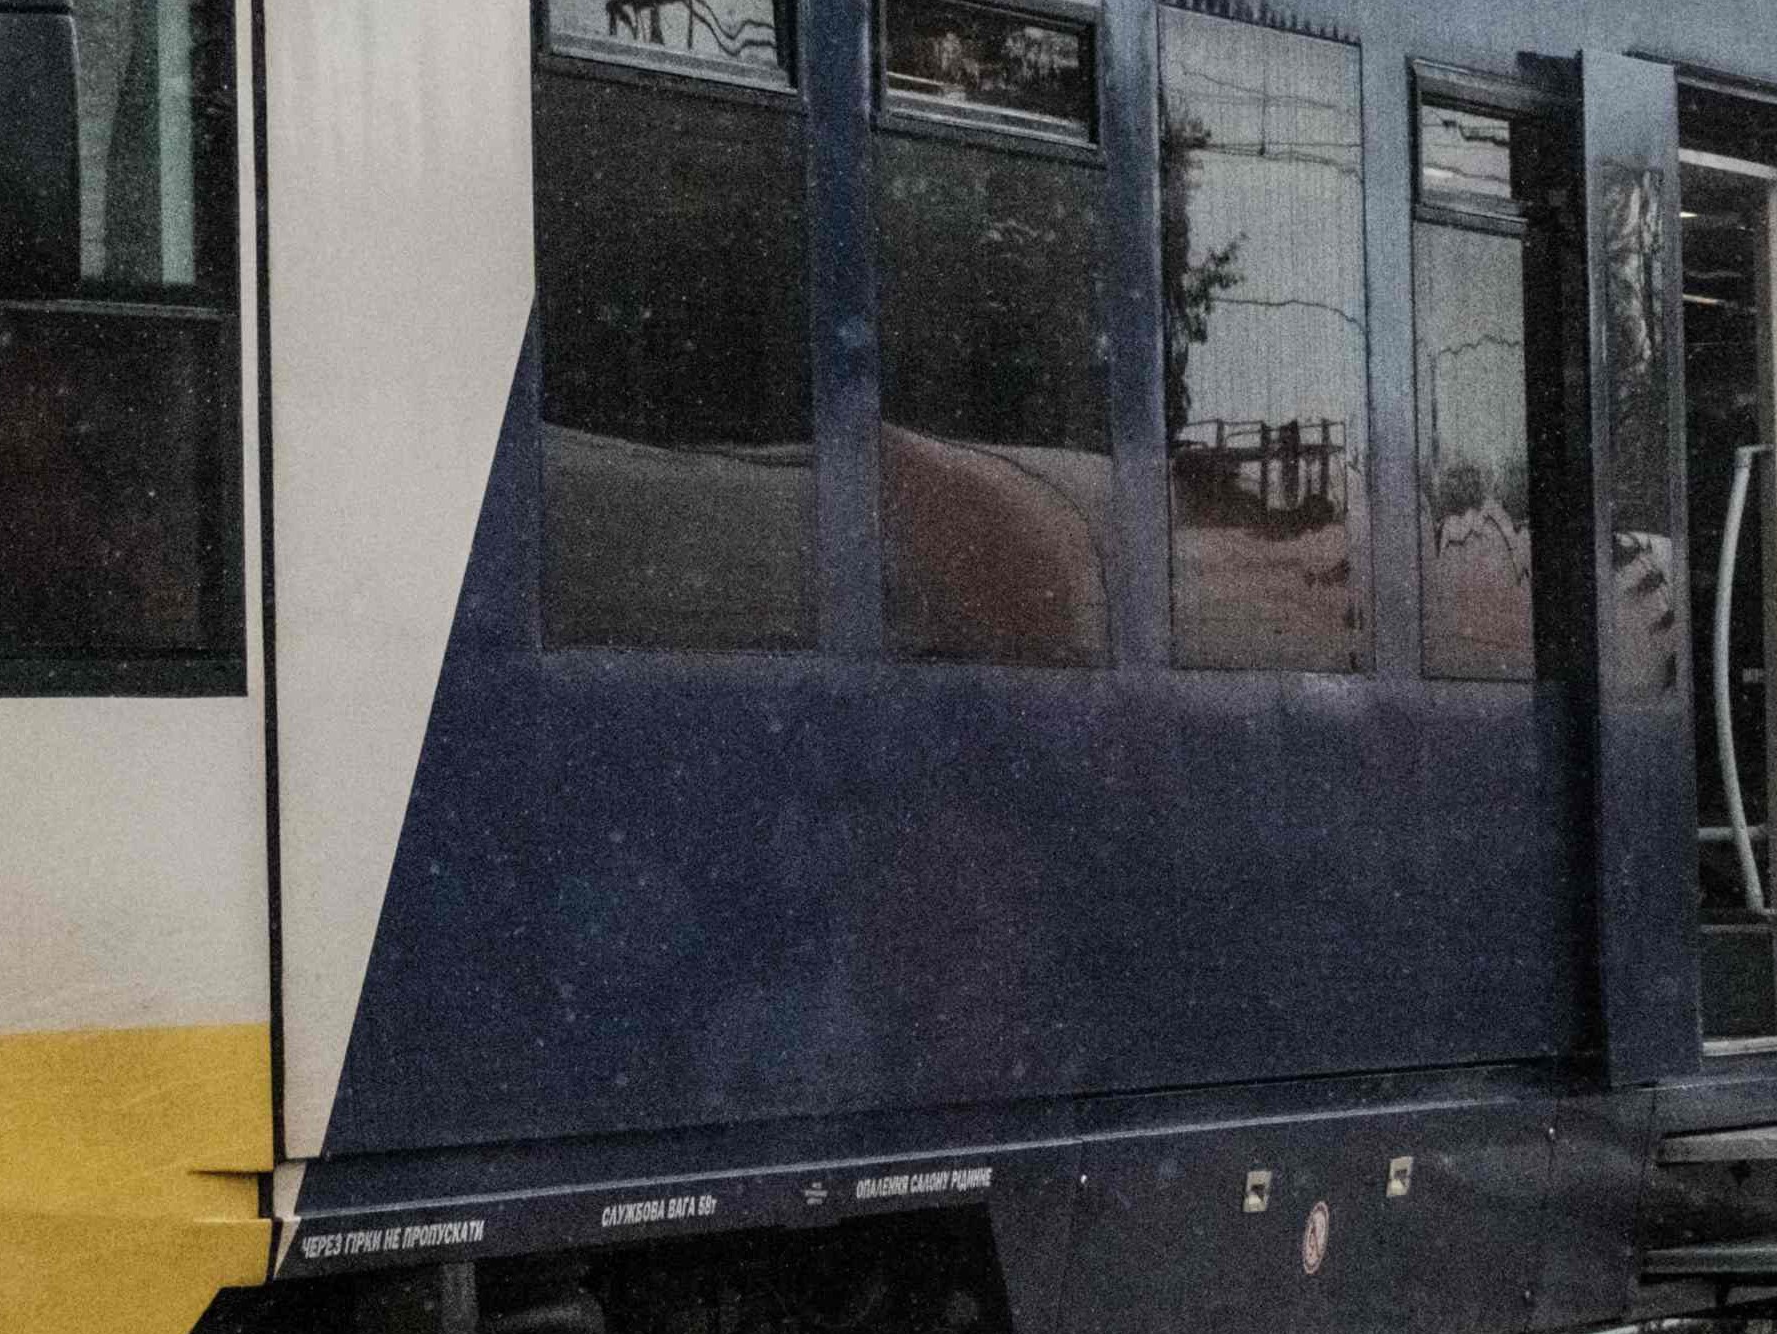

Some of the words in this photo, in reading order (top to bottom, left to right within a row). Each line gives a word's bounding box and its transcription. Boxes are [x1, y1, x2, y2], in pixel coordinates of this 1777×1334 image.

[602, 1199, 665, 1227] СЛУЖБОВА
[667, 1196, 696, 1220] ВАГА
[301, 1233, 344, 1260] ЧЕРЕЗ
[343, 1230, 384, 1255] ГІРКИ
[383, 1227, 402, 1251] НЕ
[401, 1220, 486, 1250] ПРОПУСКАТИ
